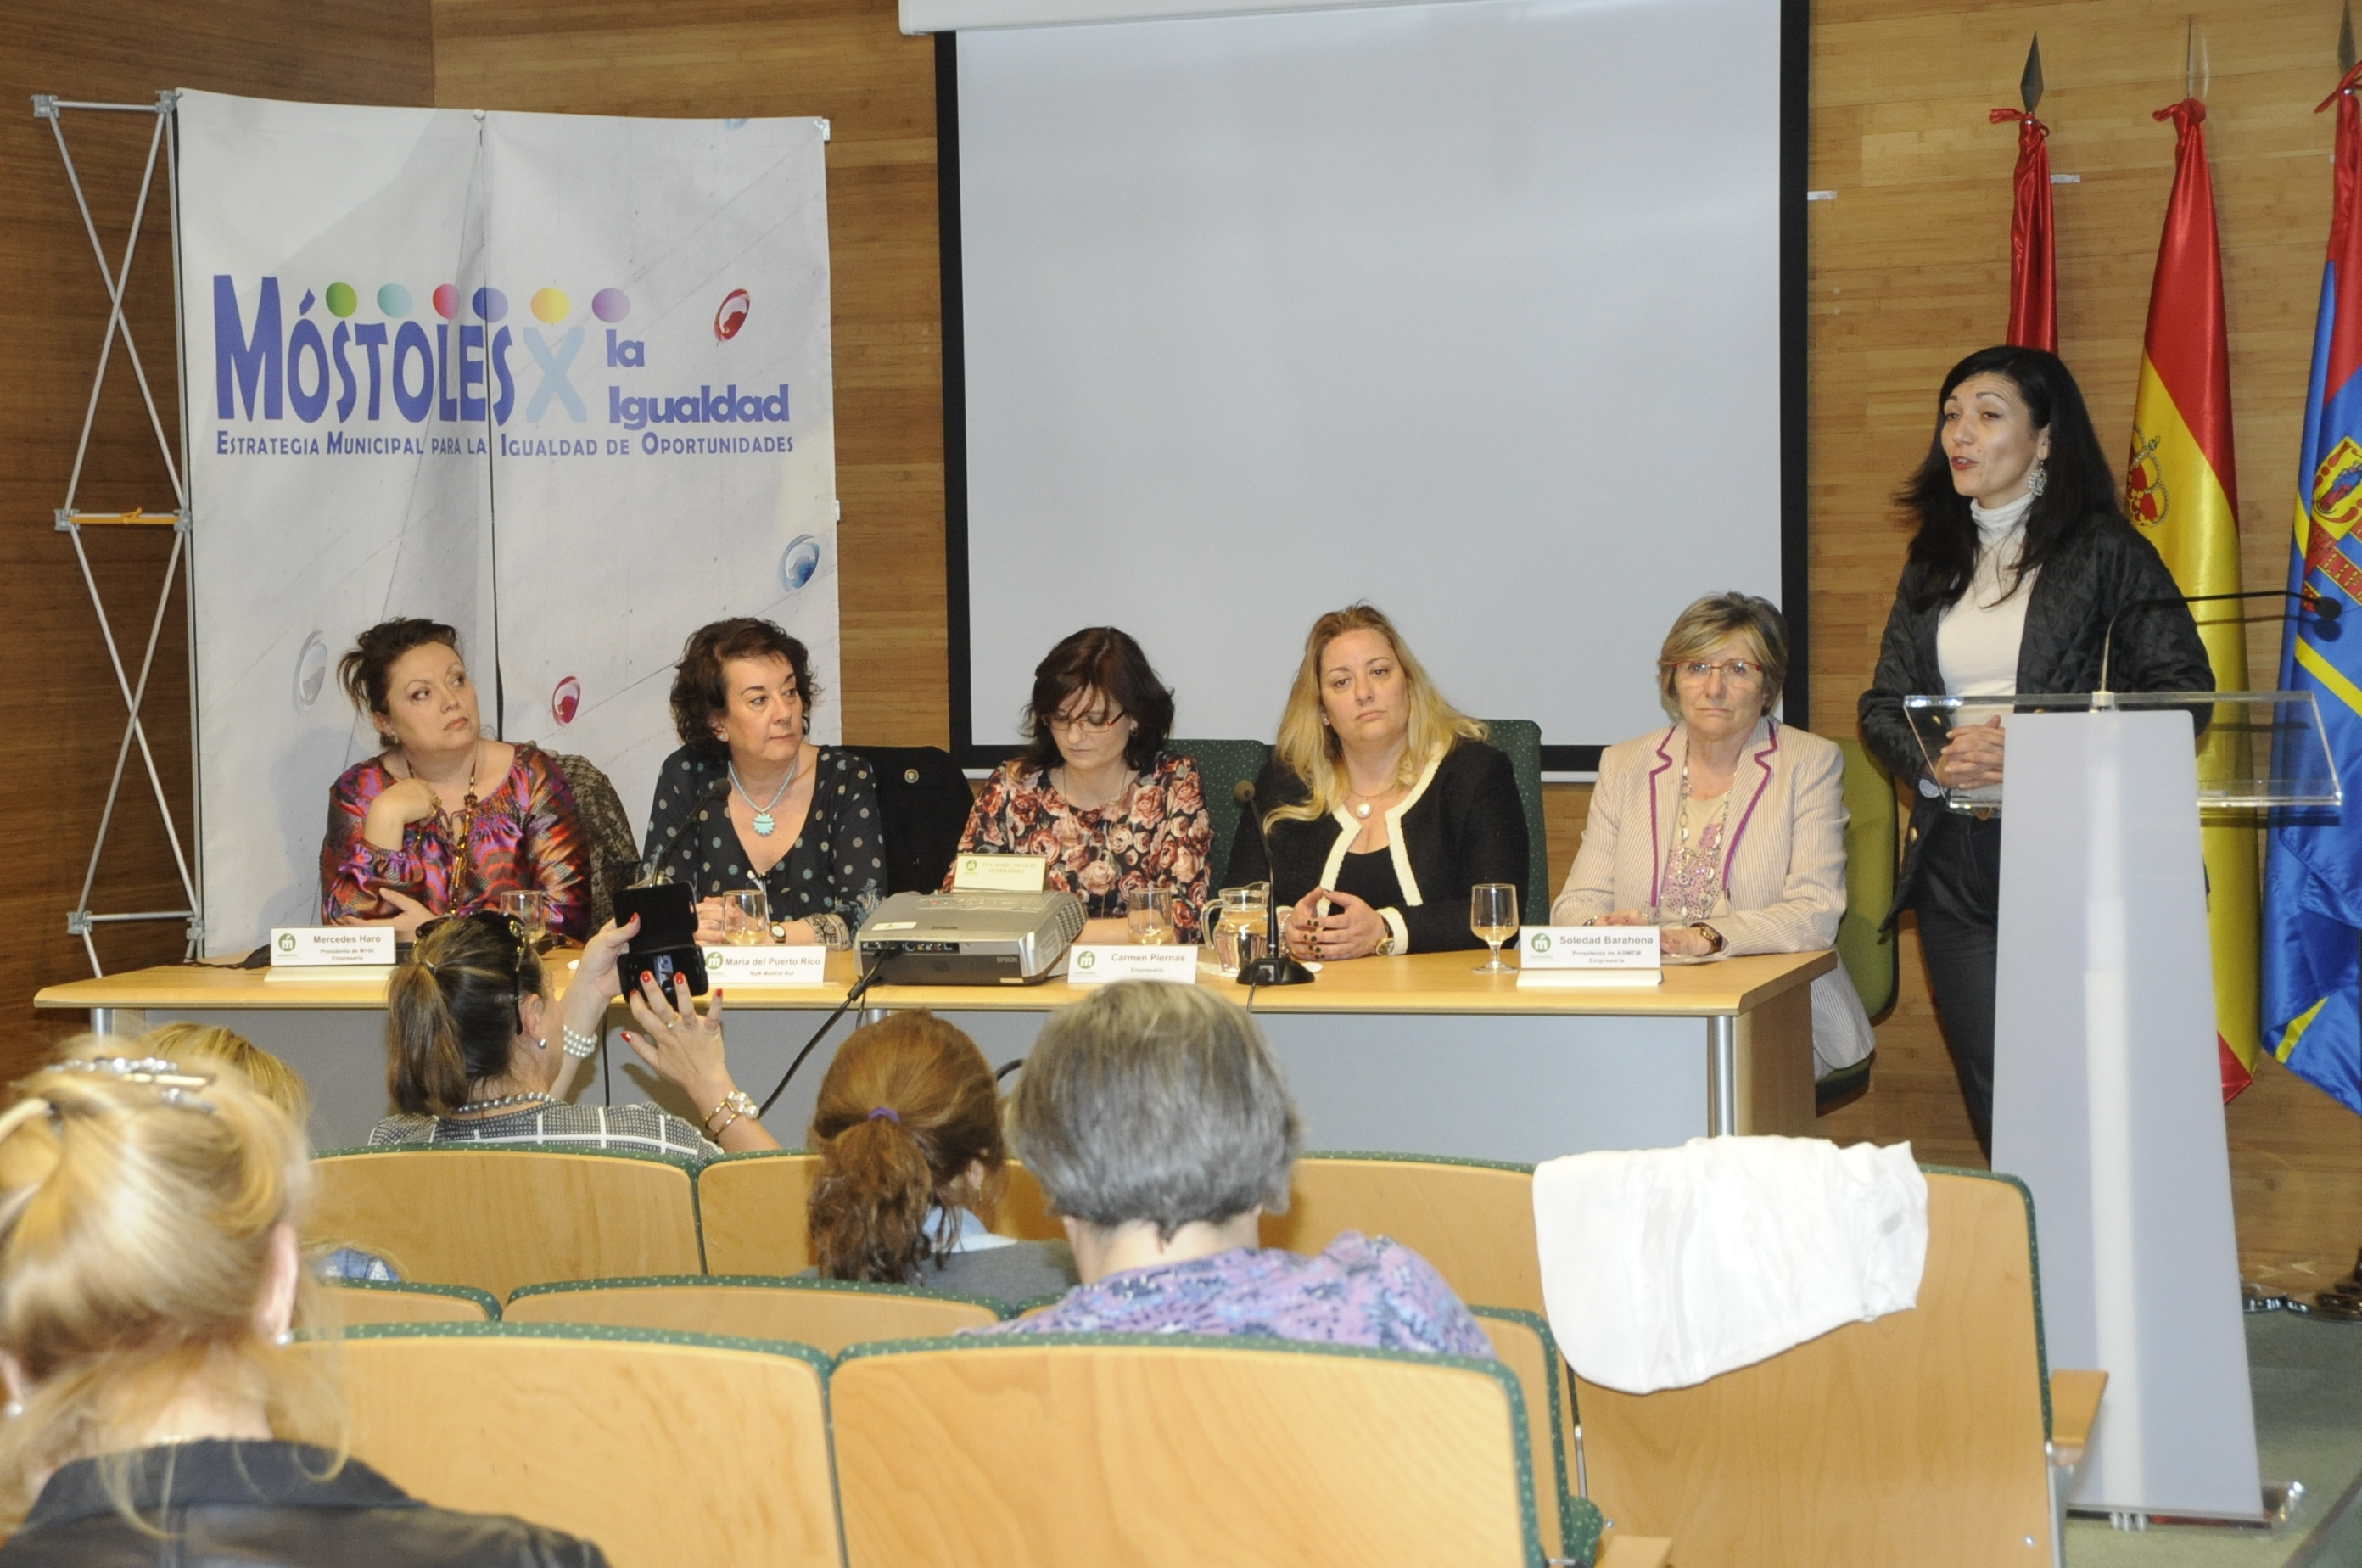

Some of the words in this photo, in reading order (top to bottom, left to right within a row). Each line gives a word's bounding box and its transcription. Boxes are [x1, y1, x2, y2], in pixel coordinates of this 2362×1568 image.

[213, 275, 515, 426] MÓSTOLES
[606, 328, 646, 367] la
[608, 383, 790, 430] Igualdad
[215, 430, 320, 455] ESTRATEGIA
[327, 430, 424, 455] MUNICIPAL
[431, 437, 462, 455] PARA
[467, 437, 487, 455] LA
[501, 434, 598, 456] IGUALDAD
[607, 439, 630, 456] DE
[641, 431, 794, 456] OPORTUNIDADES
[313, 935, 357, 944] Mercedes
[359, 934, 381, 943] Haro
[1559, 935, 1601, 944] Soledad
[1604, 935, 1654, 944] Barahona
[752, 957, 766, 966] del
[769, 957, 798, 966] Puerto
[800, 956, 821, 966] Rico
[1111, 953, 1148, 962] Carmen
[1150, 953, 1185, 962] Piernas
